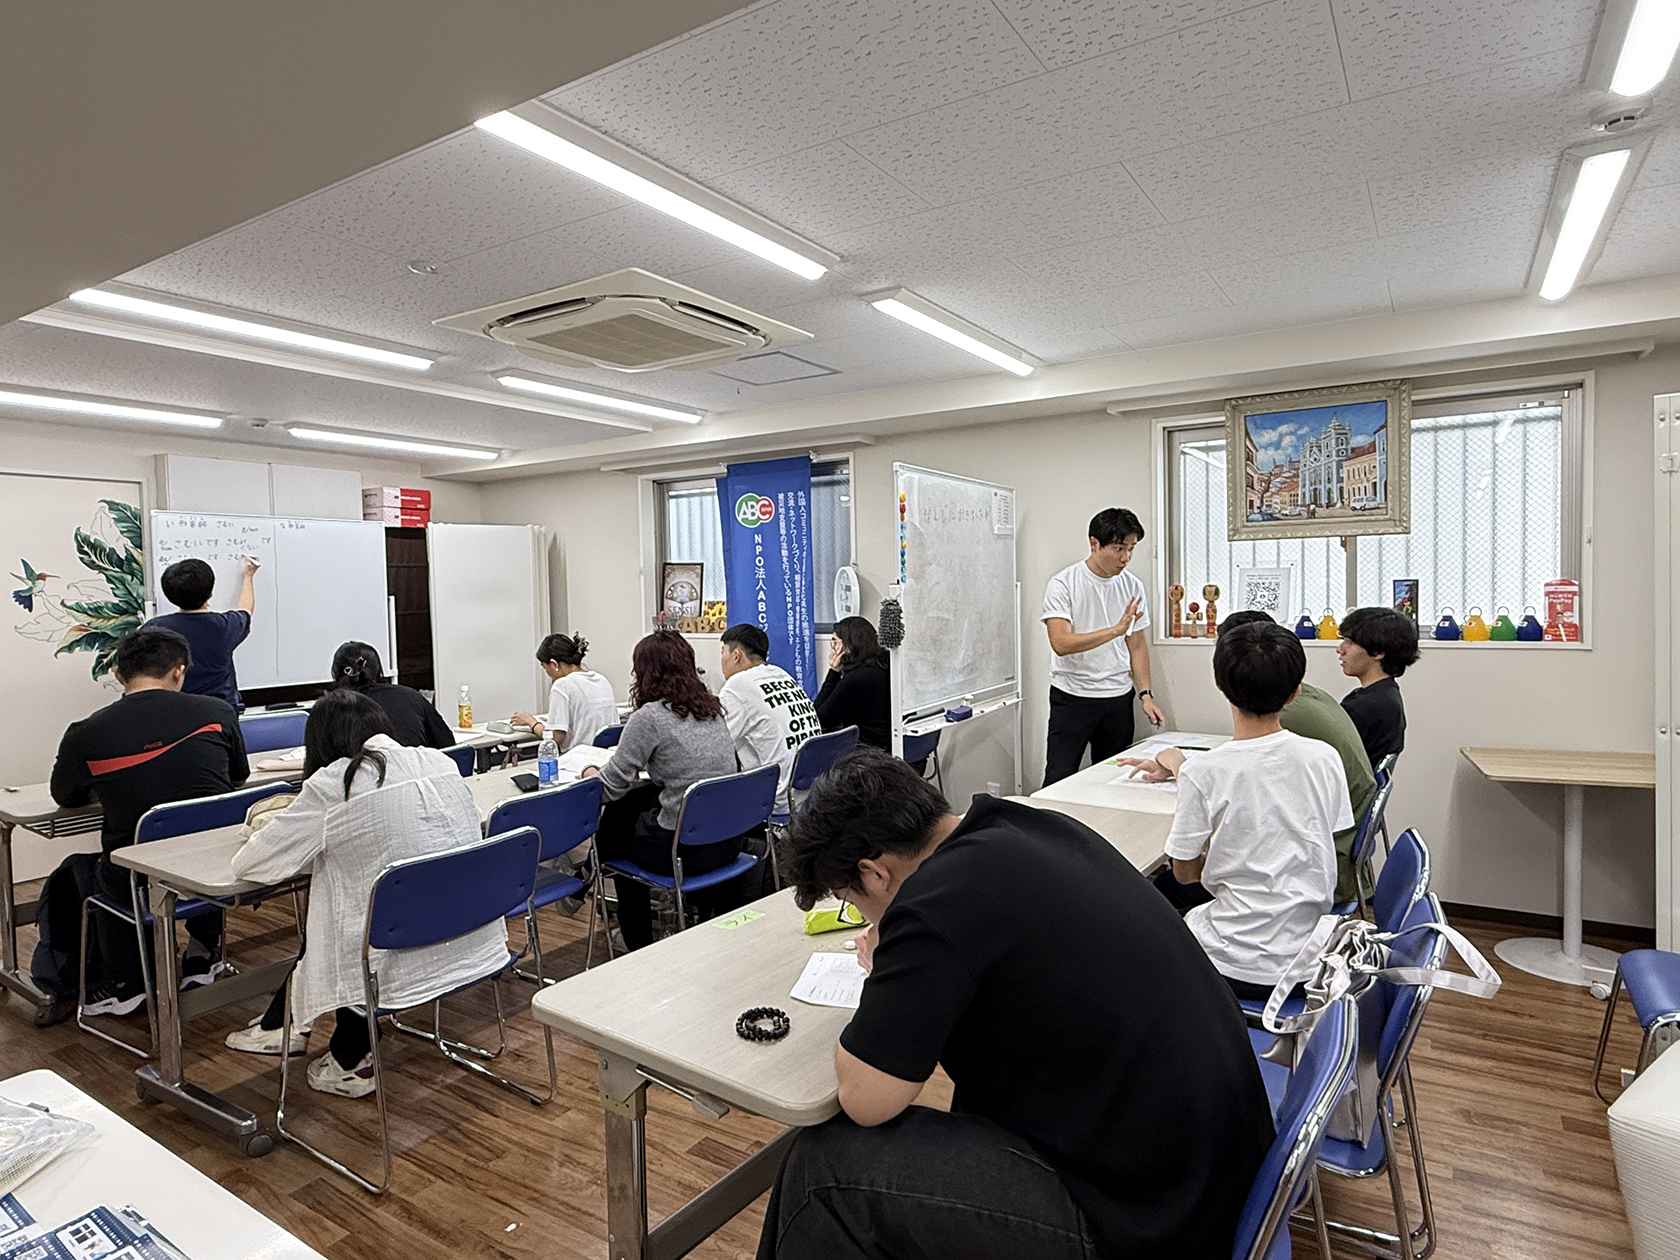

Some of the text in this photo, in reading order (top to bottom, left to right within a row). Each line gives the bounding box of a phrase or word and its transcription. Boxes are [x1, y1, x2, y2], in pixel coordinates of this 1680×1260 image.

[738, 500, 771, 520] ABC
[764, 691, 794, 709] THE
[789, 717, 806, 732] OF
